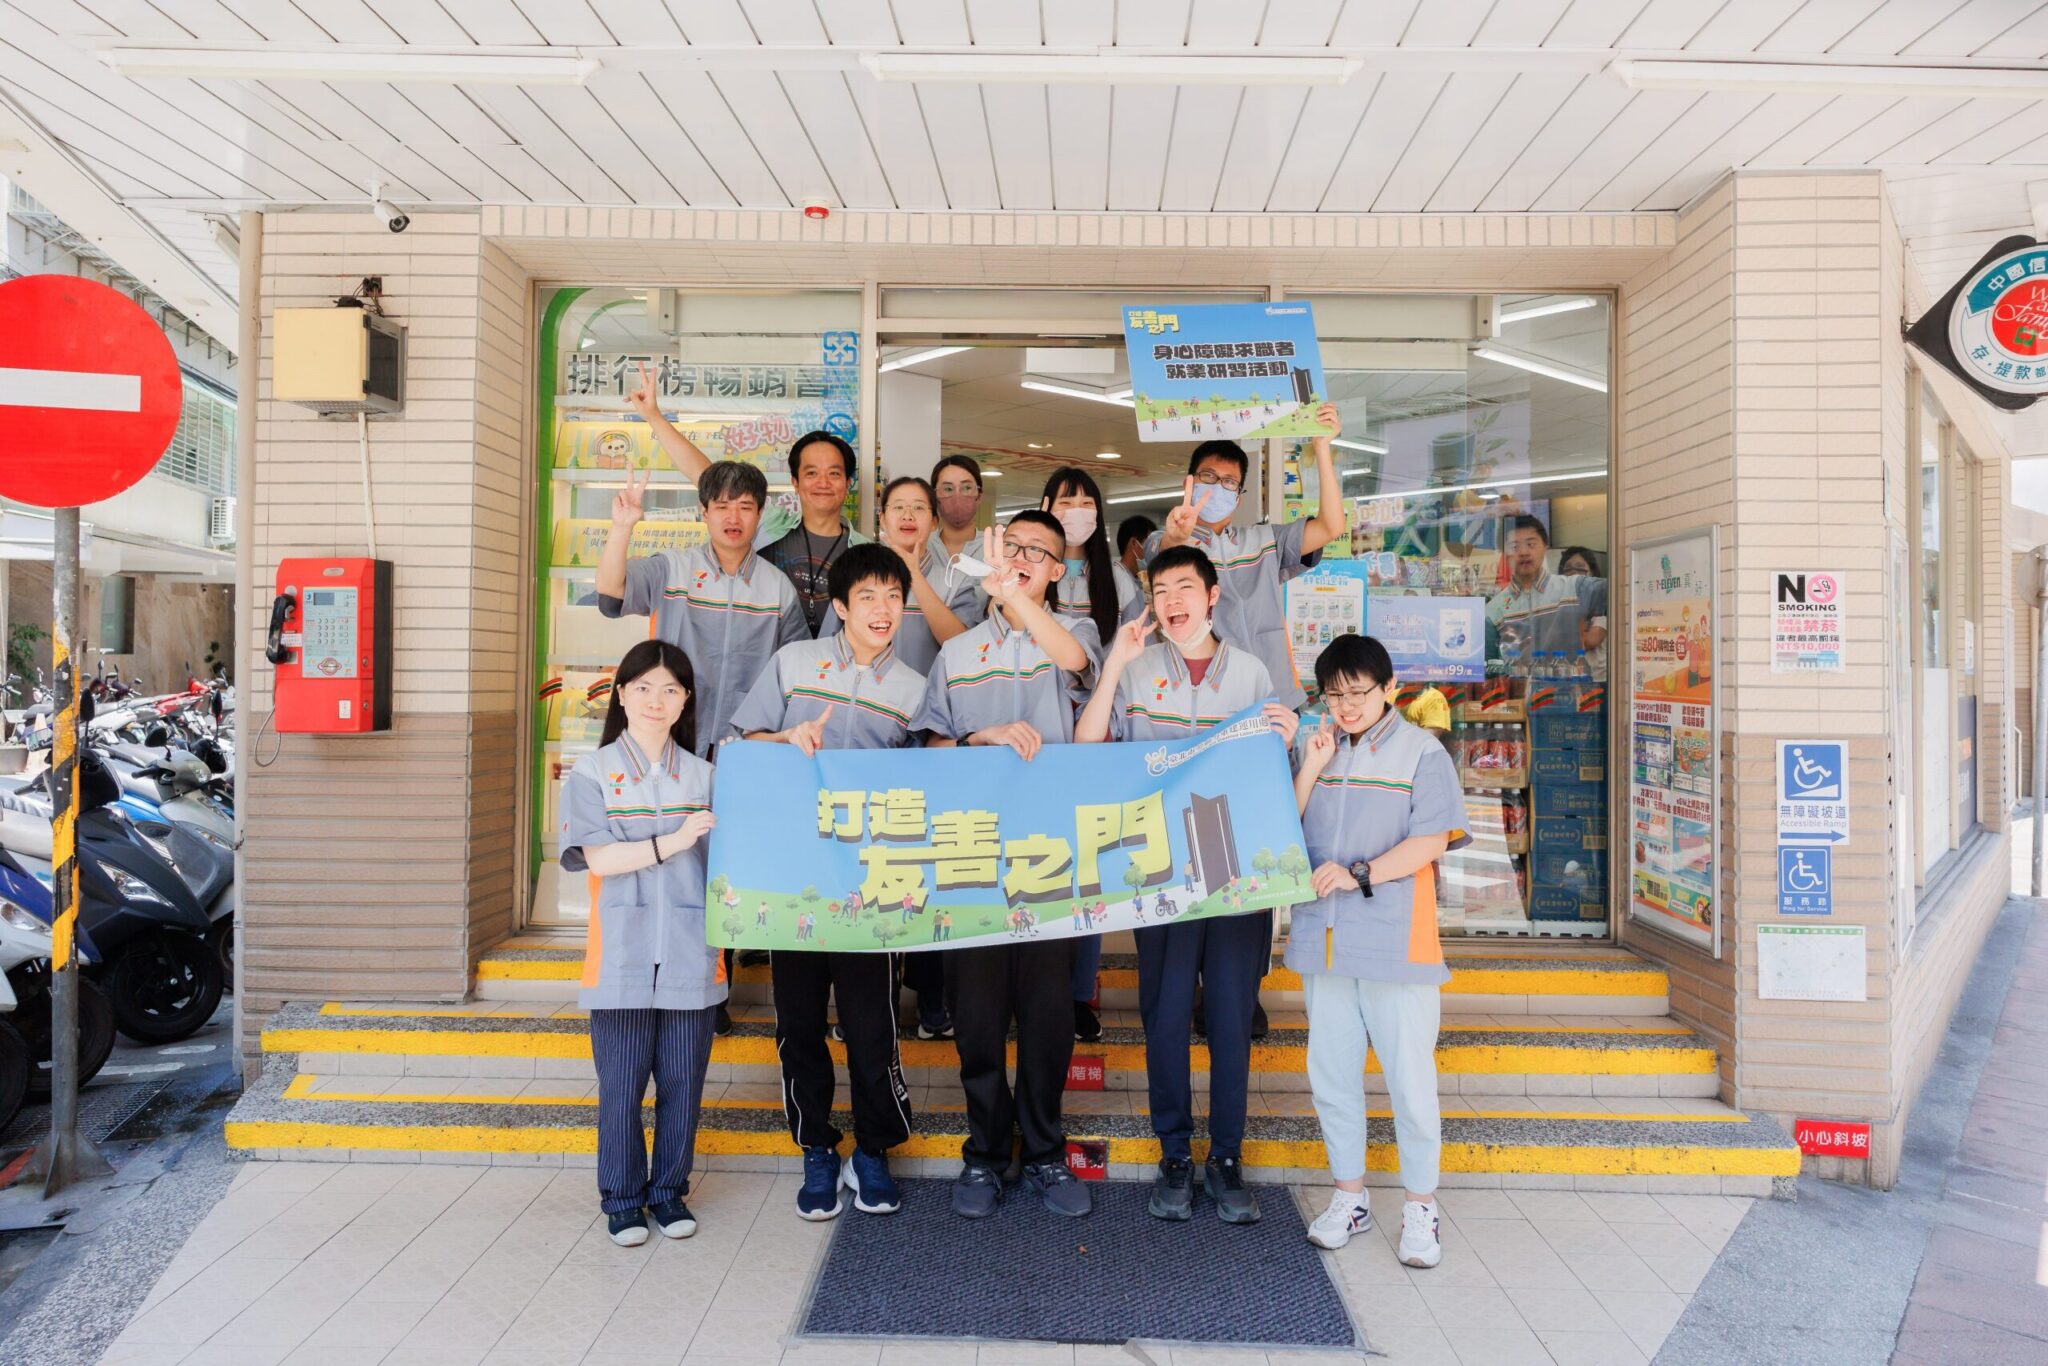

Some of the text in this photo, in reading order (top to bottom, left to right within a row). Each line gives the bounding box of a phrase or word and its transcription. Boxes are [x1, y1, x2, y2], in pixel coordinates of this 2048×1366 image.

[1153, 341, 1295, 361] 身心障礙求職者
[567, 354, 829, 398] 排行榜暢銷書
[1165, 361, 1290, 380] 就業研習活動
[1778, 604, 1837, 612] SMOKING
[817, 788, 928, 844] 打造
[1780, 805, 1846, 818] 無障礙坡道
[1824, 820, 1846, 828] Ramp
[859, 790, 1174, 914] 友善之門
[1067, 1066, 1102, 1081] 階梯
[1798, 1129, 1868, 1148] 小心斜坡
